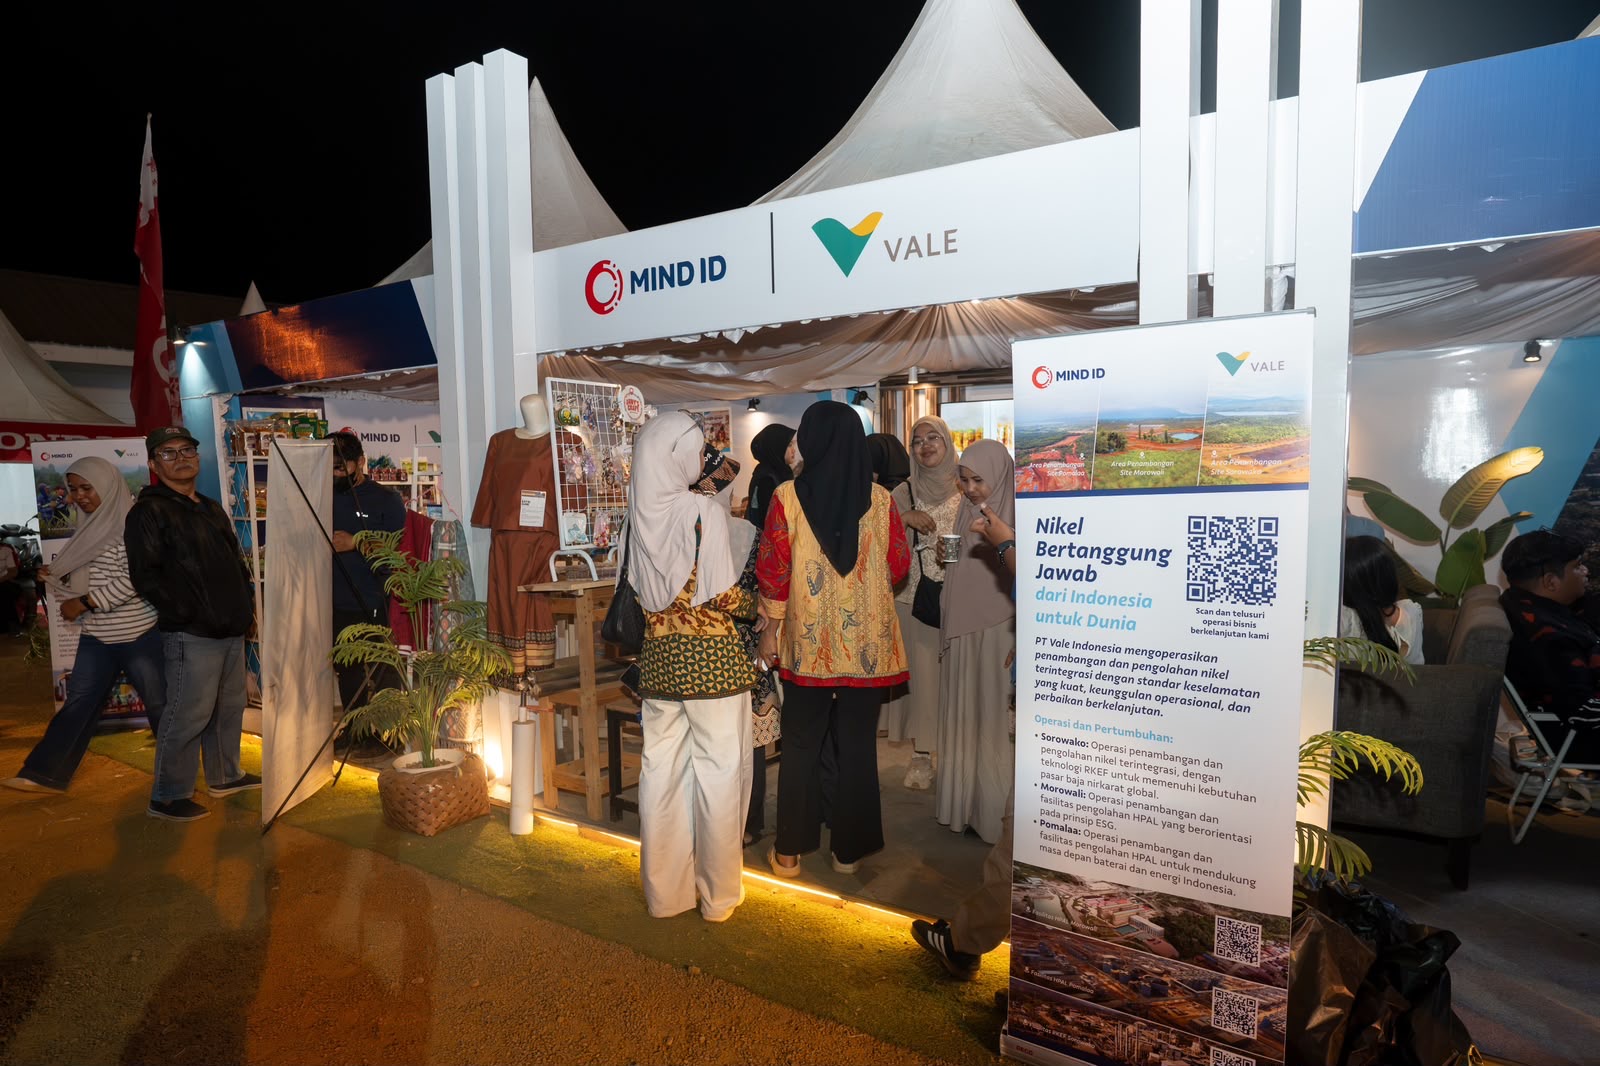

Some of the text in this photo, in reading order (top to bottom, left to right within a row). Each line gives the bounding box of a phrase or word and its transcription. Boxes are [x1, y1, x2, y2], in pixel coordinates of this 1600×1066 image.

[883, 228, 958, 263] VALE
[630, 254, 727, 295] MIND ID
[1056, 368, 1106, 382] MIND ID
[1251, 360, 1285, 372] VALE
[361, 433, 400, 442] MIND ID
[1126, 460, 1174, 469] Penambangan
[1036, 516, 1084, 535] Nikel
[1036, 540, 1172, 568] Bertanggung
[1036, 564, 1097, 582] Jawab
[1036, 586, 1153, 608] dari Indonesia
[1036, 609, 1137, 631] untuk Dunia
[1196, 607, 1265, 619] Scan dan telusuri
[1202, 618, 1256, 629] operasi bisnis
[1190, 627, 1269, 640] berkelanjutan kami
[1035, 636, 1218, 664] PT Vale Indonesia mengoperasikan
[1035, 651, 1229, 680] penambangan dan pengolahan nikel
[1035, 664, 1261, 699] terintegrasi dengan standar keselamatan
[1034, 678, 1251, 714] yang kuat, keunggulan operasional, dan
[1034, 691, 1164, 717] perbaikan berkelanjutan.
[1034, 714, 1174, 744] Operasi dan Pertumbuhan:
[1041, 732, 1223, 770] Sorowako: Operasi penambangan dan
[1041, 746, 1221, 784] pengolahan nikel terintegrasi, dengan
[1040, 770, 1159, 800] pasar baja nirkarat global.
[1041, 758, 1257, 803] teknologi RKEF untuk memenuhi kebutuhan
[1040, 782, 1219, 825] Morowali: Operasi penambangan dan
[1040, 808, 1117, 830] pada prinsip ESG.
[1040, 794, 1252, 845] fasilitas pengolahan HPAL yang berorientasi
[1040, 819, 1213, 864] Pomalaa: Operasi penambangan dan
[1040, 830, 1257, 890] fasilitas pengolahan HPAL untuk mendukung
[1040, 844, 1236, 897] masa depan baterai dan energi Indonesia.
